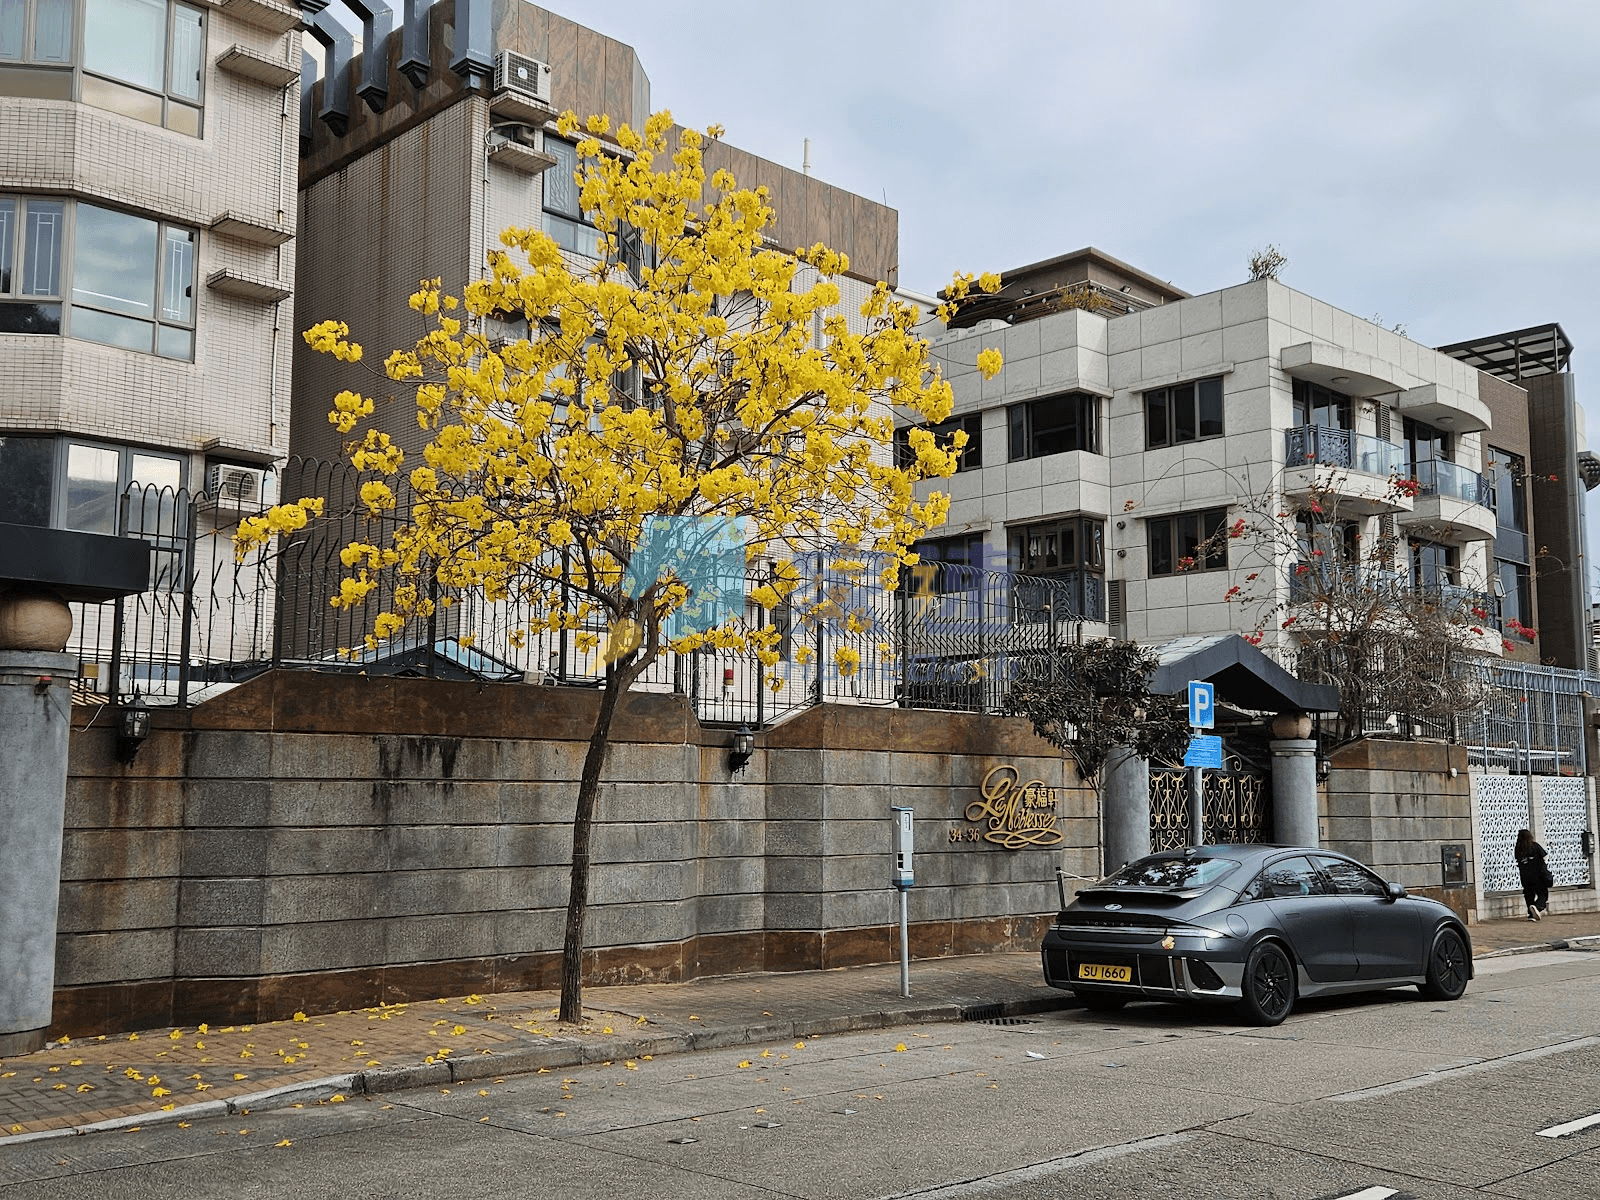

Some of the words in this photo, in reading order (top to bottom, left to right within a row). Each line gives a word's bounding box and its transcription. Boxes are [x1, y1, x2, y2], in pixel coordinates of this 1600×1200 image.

[1194, 687, 1210, 723] P
[988, 779, 1058, 832] Noblesse
[1023, 788, 1059, 811] 豪福軒
[1083, 966, 1098, 977] SU
[1102, 967, 1126, 979] 1660
